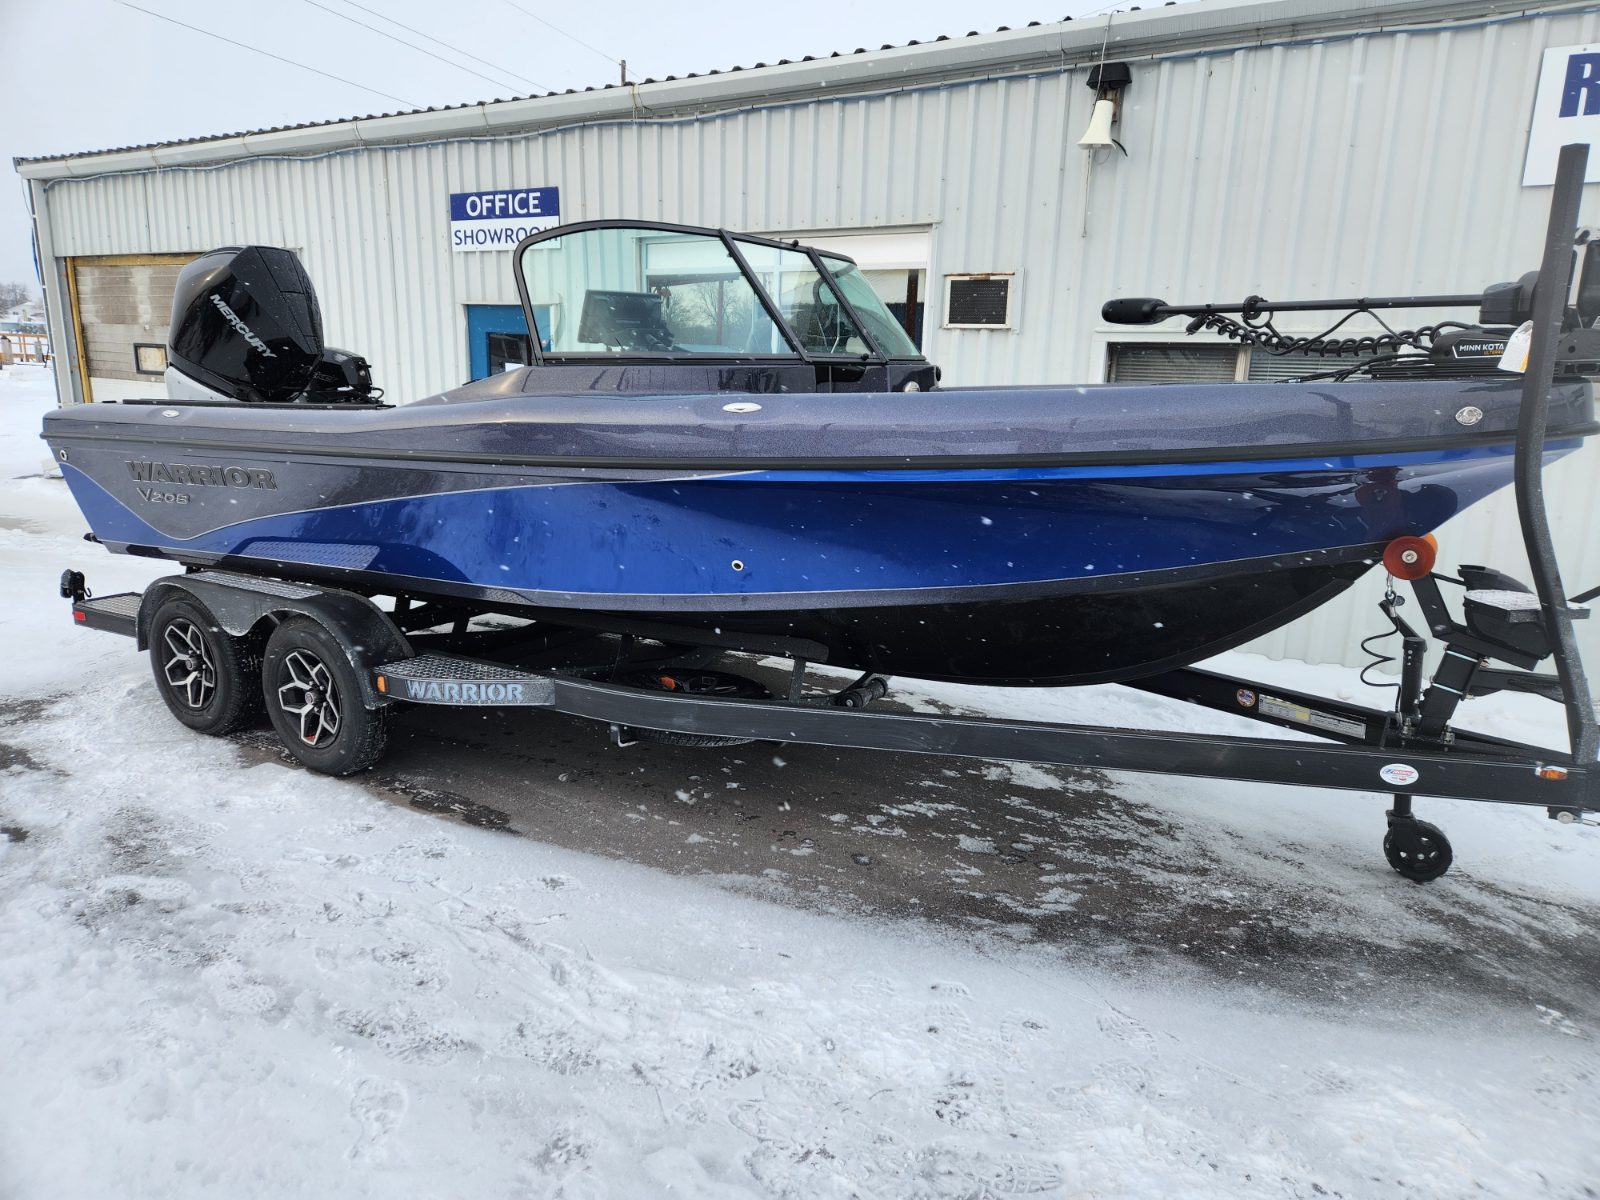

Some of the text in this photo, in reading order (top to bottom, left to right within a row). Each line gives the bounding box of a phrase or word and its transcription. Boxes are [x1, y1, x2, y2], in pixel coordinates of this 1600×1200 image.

[465, 191, 542, 217] OFFICE
[454, 226, 558, 246] SHOWRO
[209, 293, 278, 359] MERCURY
[1482, 343, 1504, 351] KOTA
[125, 460, 278, 491] WARRIOR
[406, 681, 524, 702] WARRIOR
